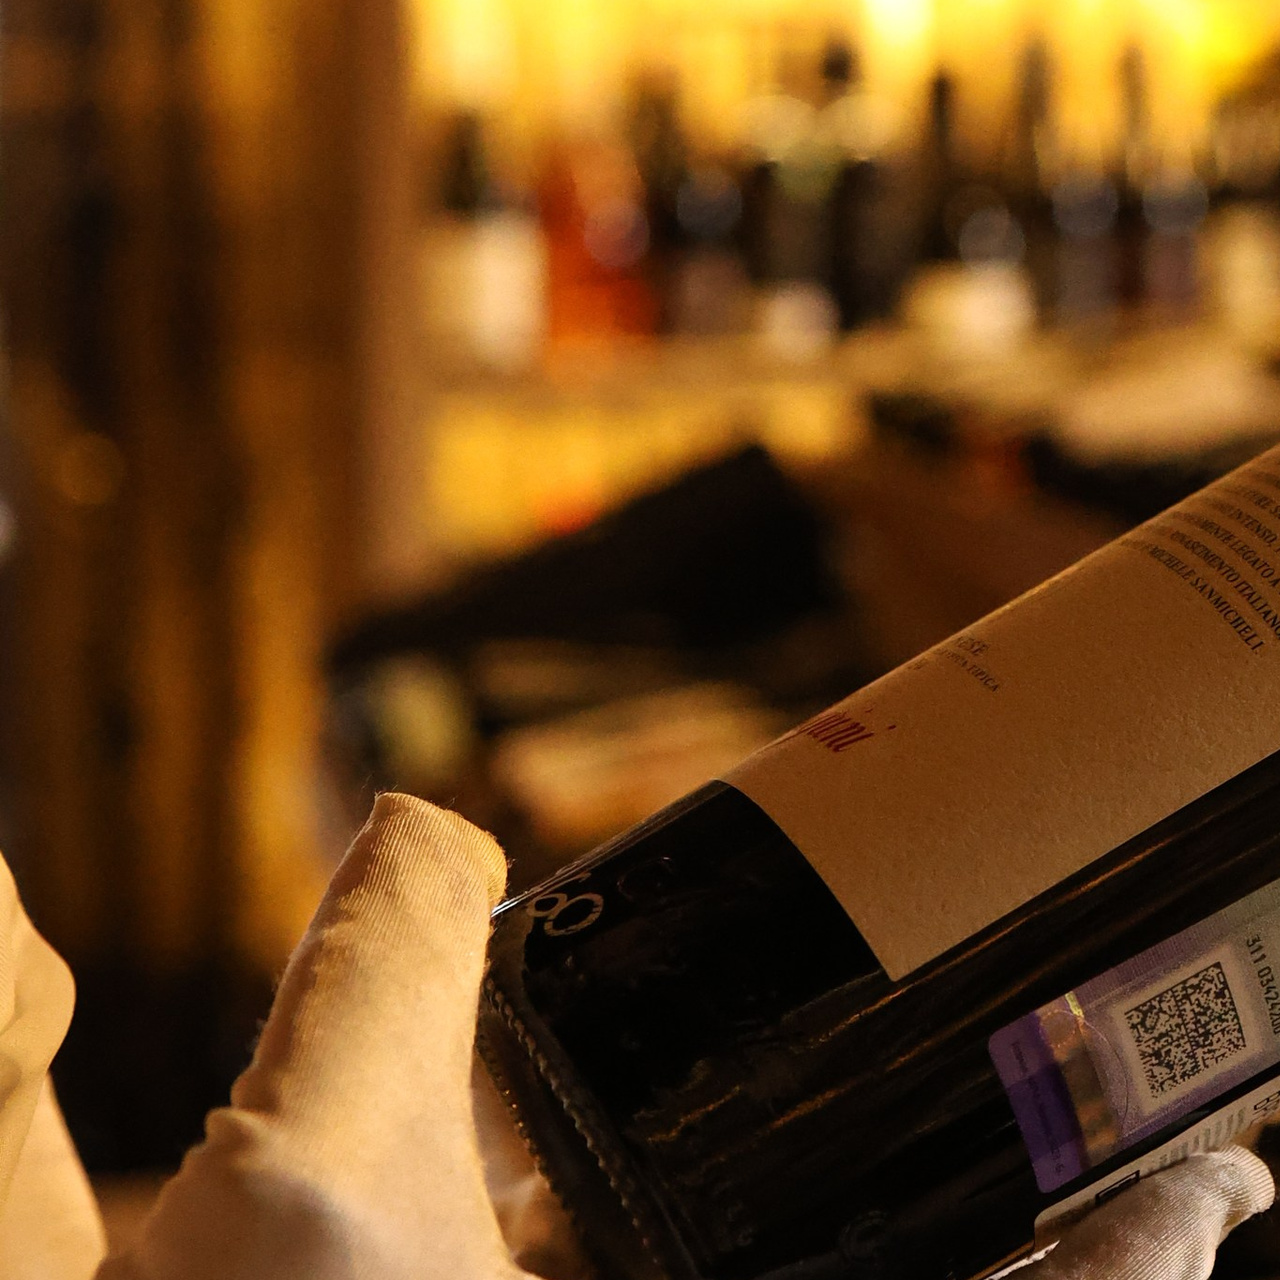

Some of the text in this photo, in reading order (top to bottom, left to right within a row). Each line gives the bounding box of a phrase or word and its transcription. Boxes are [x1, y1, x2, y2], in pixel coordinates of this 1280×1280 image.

[1230, 540, 1275, 580] LEGATO
[1269, 577, 1280, 588] A
[1190, 576, 1265, 655] SANMICHELI.
[1245, 934, 1267, 964] 311
